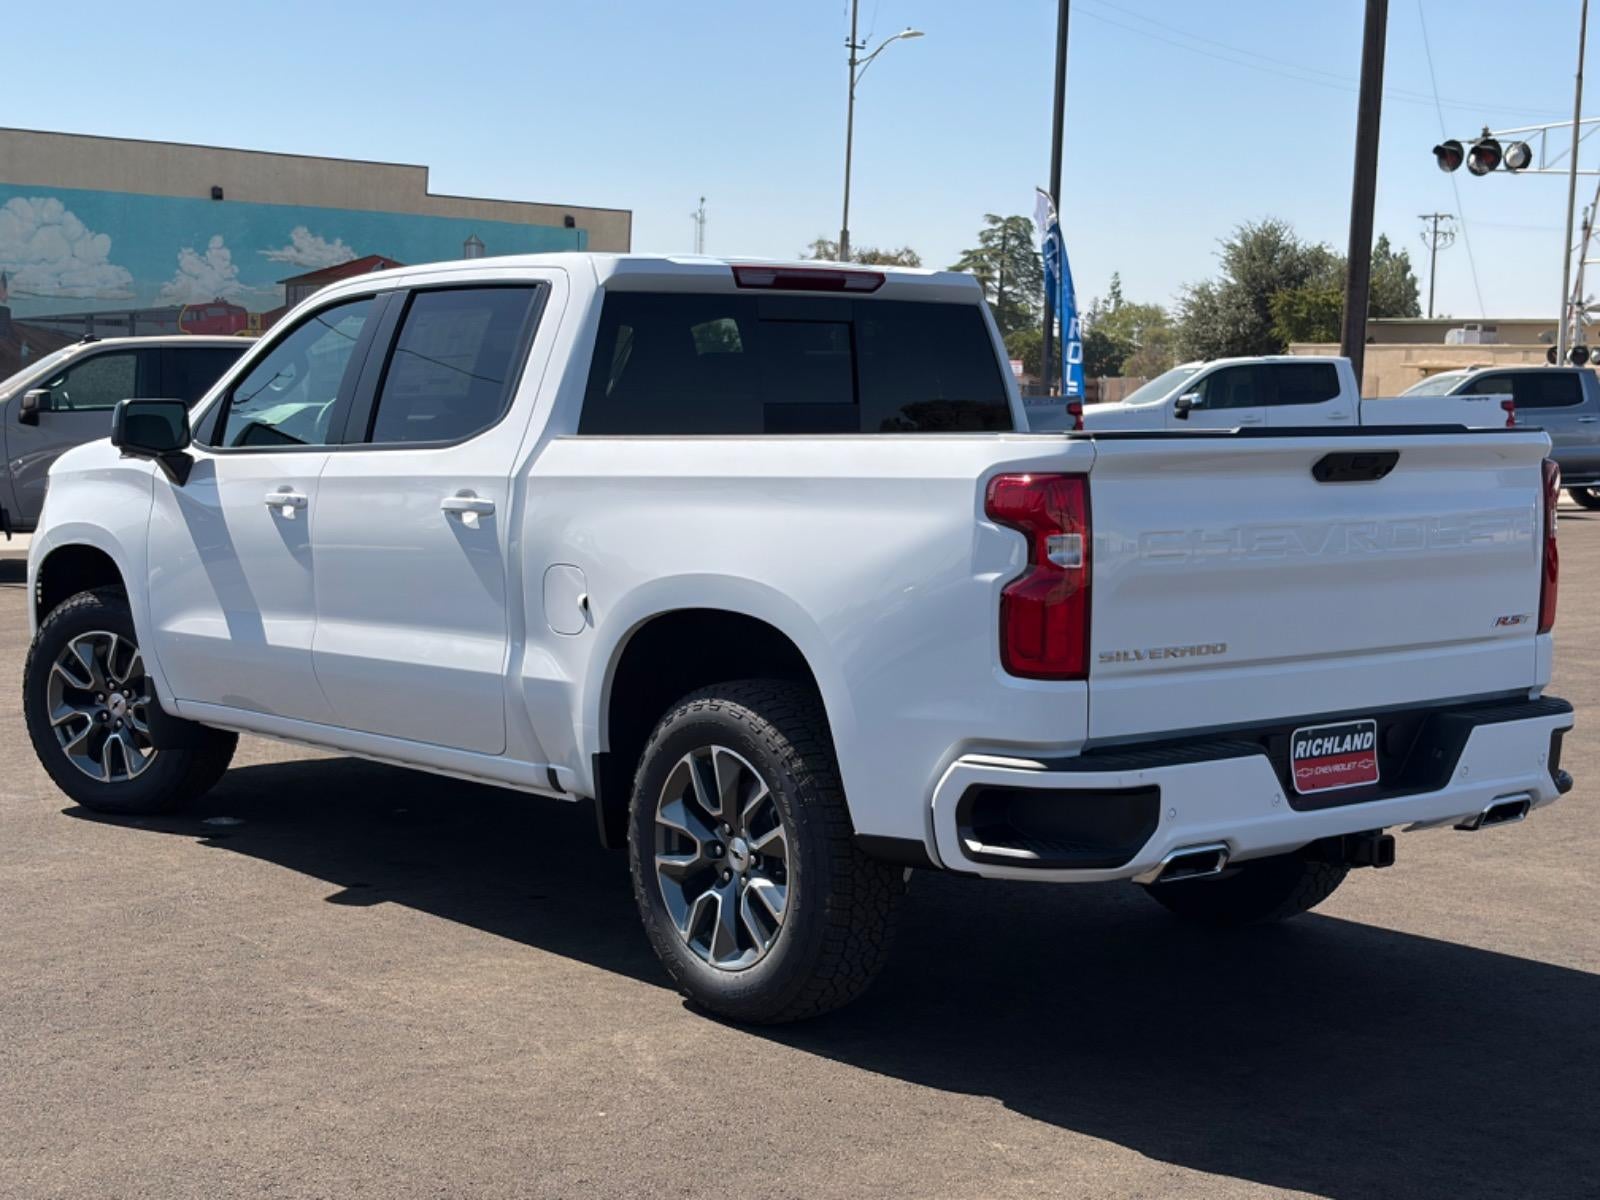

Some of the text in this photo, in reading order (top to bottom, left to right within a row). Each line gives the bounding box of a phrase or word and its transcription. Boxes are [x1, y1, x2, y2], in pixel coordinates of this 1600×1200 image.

[1098, 643, 1227, 663] SILVERADO
[1295, 732, 1374, 759] RICHLAND
[1314, 761, 1357, 775] CHEVROLET
